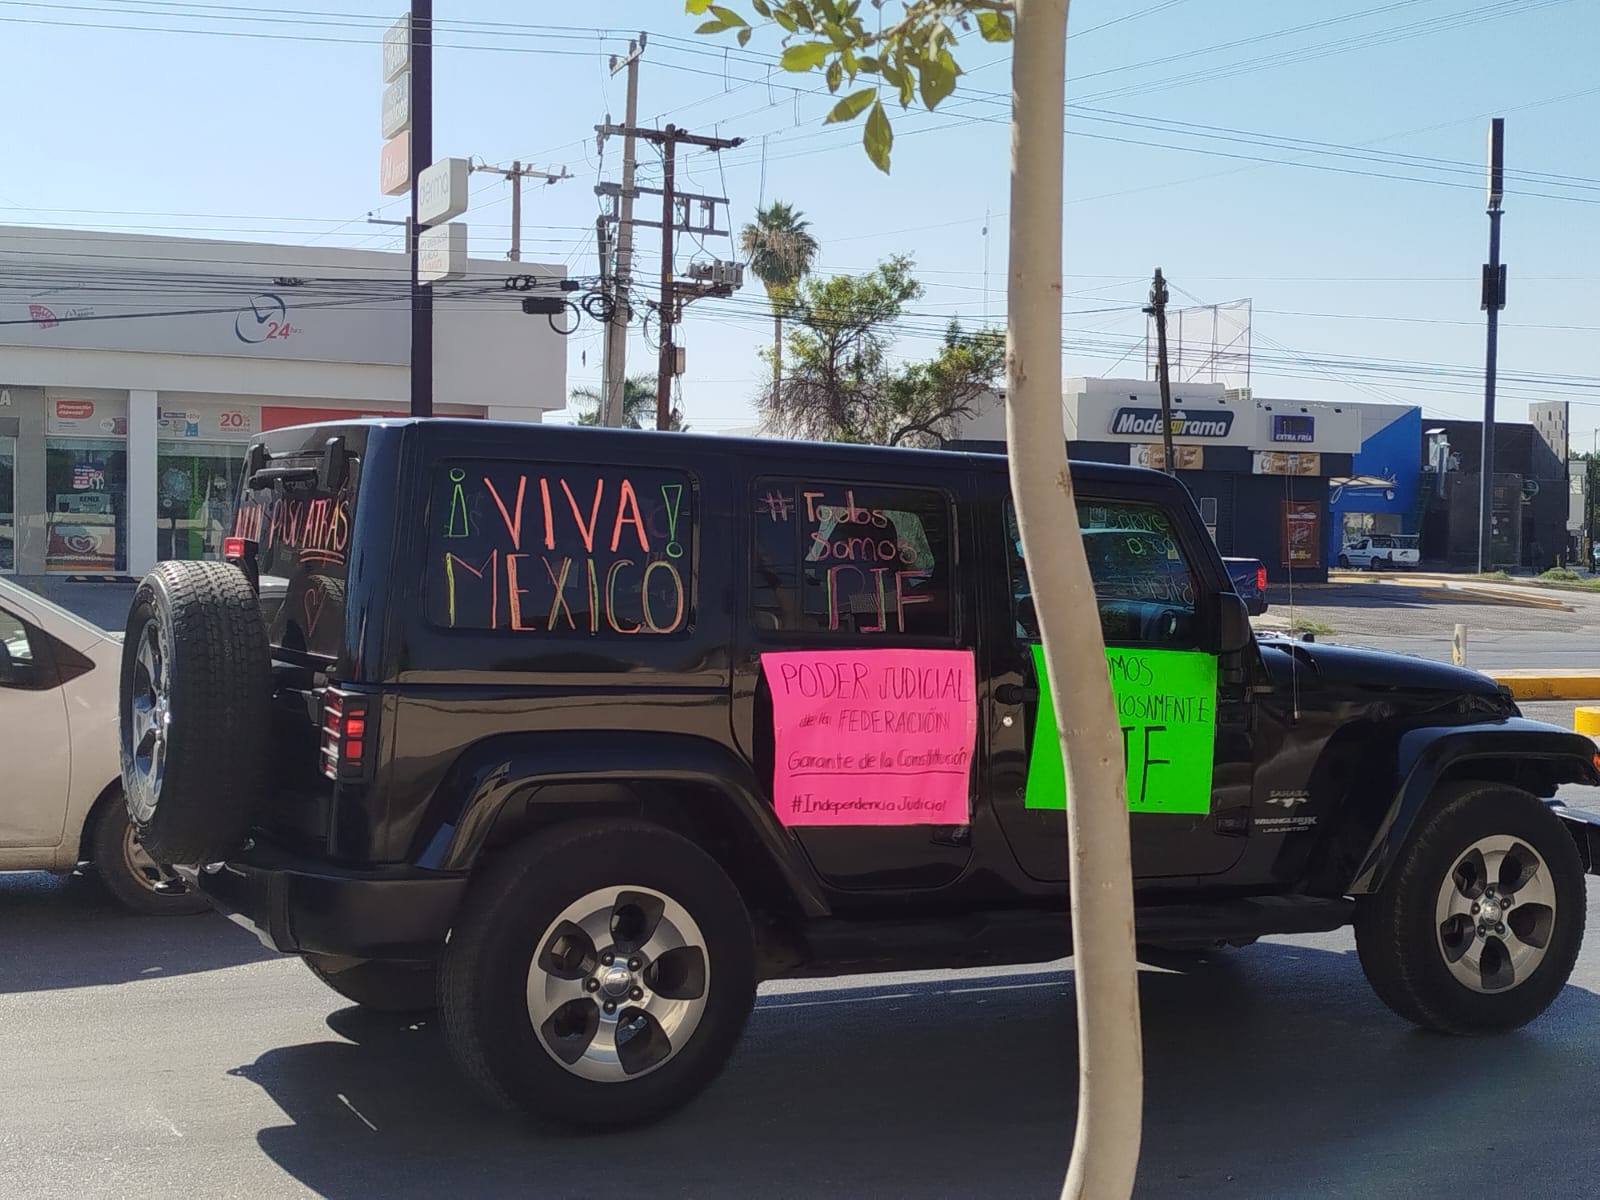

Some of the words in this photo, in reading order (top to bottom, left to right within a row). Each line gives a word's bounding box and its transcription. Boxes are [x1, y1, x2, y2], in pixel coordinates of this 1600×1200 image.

[266, 321, 290, 340] 24
[1275, 432, 1296, 441] EXTRA
[1297, 431, 1313, 442] FRÍA
[445, 549, 684, 635] MEXICO
[780, 662, 870, 700] PODER
[879, 666, 971, 703] JUDICIAL
[800, 712, 815, 728] de
[818, 711, 831, 726] la
[838, 706, 950, 734] FEDERACIÓN
[788, 750, 854, 771] Garante
[858, 752, 876, 769] de
[880, 751, 894, 769] la
